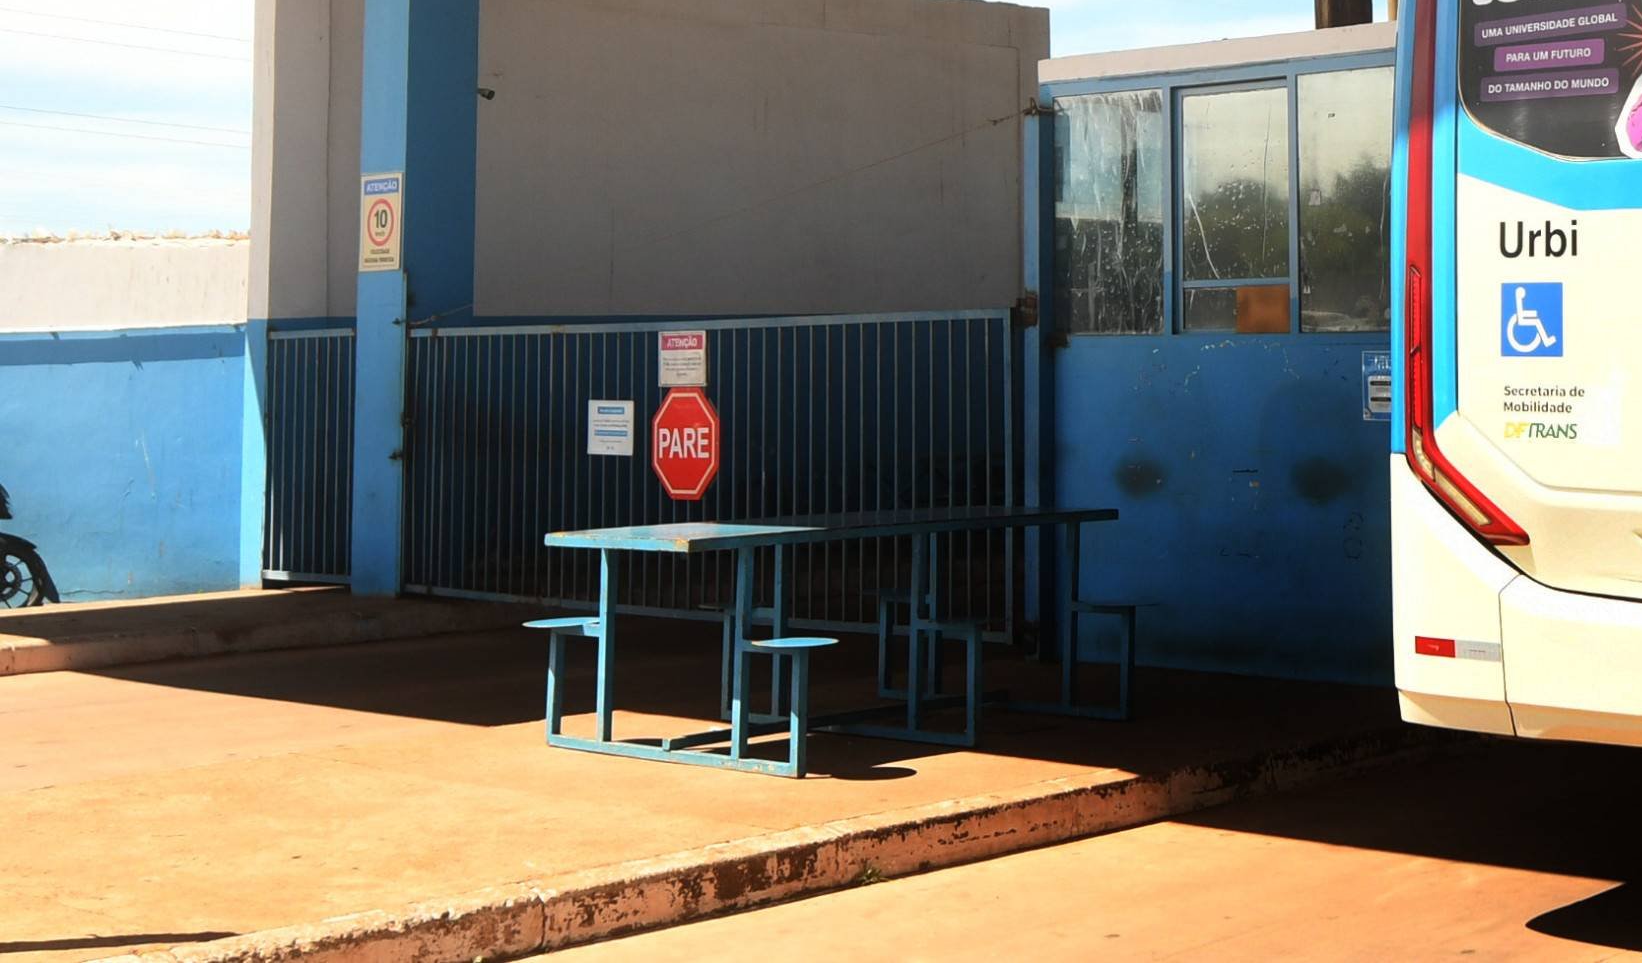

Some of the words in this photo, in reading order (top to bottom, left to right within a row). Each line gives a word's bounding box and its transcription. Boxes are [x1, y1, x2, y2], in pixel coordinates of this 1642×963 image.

[1482, 29, 1503, 39] UMA
[1505, 18, 1576, 36] UNIVERSIDADE
[1577, 12, 1618, 27] GLOBAL
[1506, 52, 1530, 63] PARA
[1533, 51, 1549, 61] UM
[1551, 47, 1591, 60] FUTURO
[1488, 84, 1502, 94] DO
[1505, 82, 1552, 92] TAMANHO
[1554, 81, 1568, 90] DO
[1571, 77, 1610, 89] MUNDO
[374, 209, 388, 229] 10
[1500, 219, 1578, 258] Urbi
[1504, 385, 1566, 397] Secretaria
[1569, 386, 1585, 397] de
[1503, 401, 1573, 413] Mobilidade
[659, 427, 710, 459] PARE
